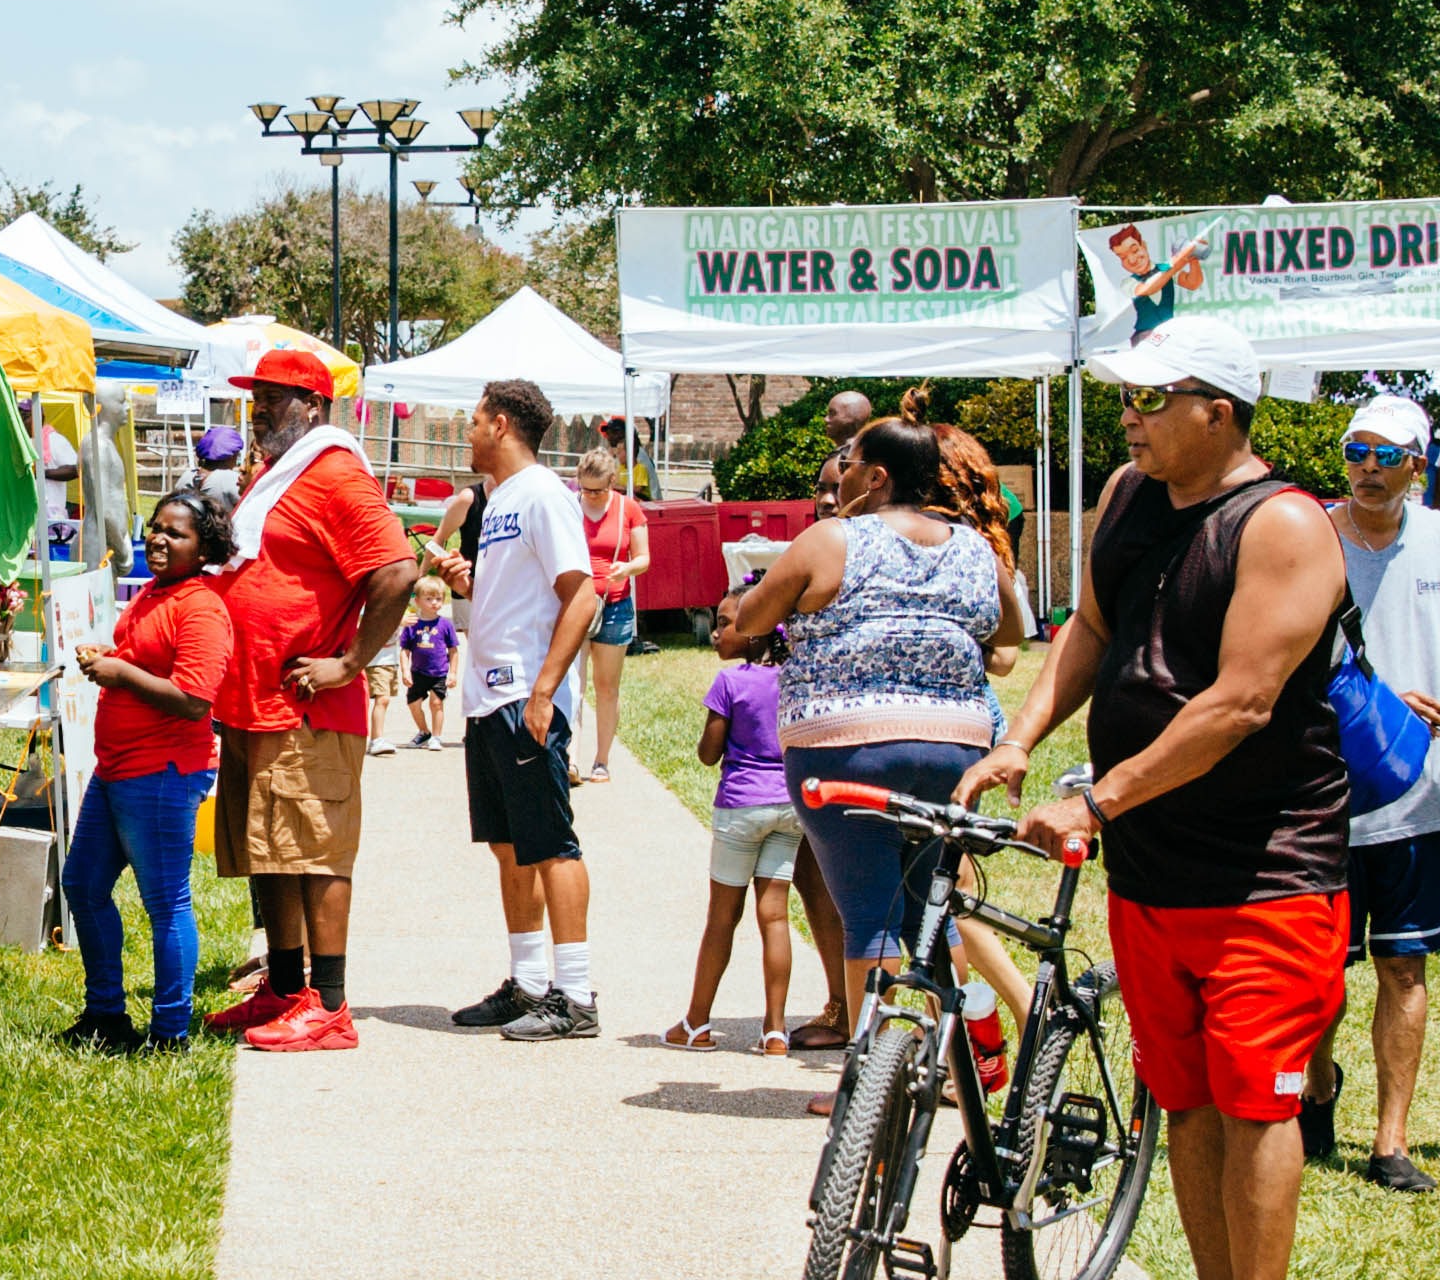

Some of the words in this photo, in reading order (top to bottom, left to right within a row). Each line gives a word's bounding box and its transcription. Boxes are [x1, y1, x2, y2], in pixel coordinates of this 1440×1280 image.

[689, 213, 870, 250] MARGARITA
[882, 208, 1016, 246] FESTIVAL
[1222, 224, 1356, 275] MIXED
[697, 247, 835, 294] WATER
[848, 246, 878, 293] &
[890, 245, 1002, 292] SODA
